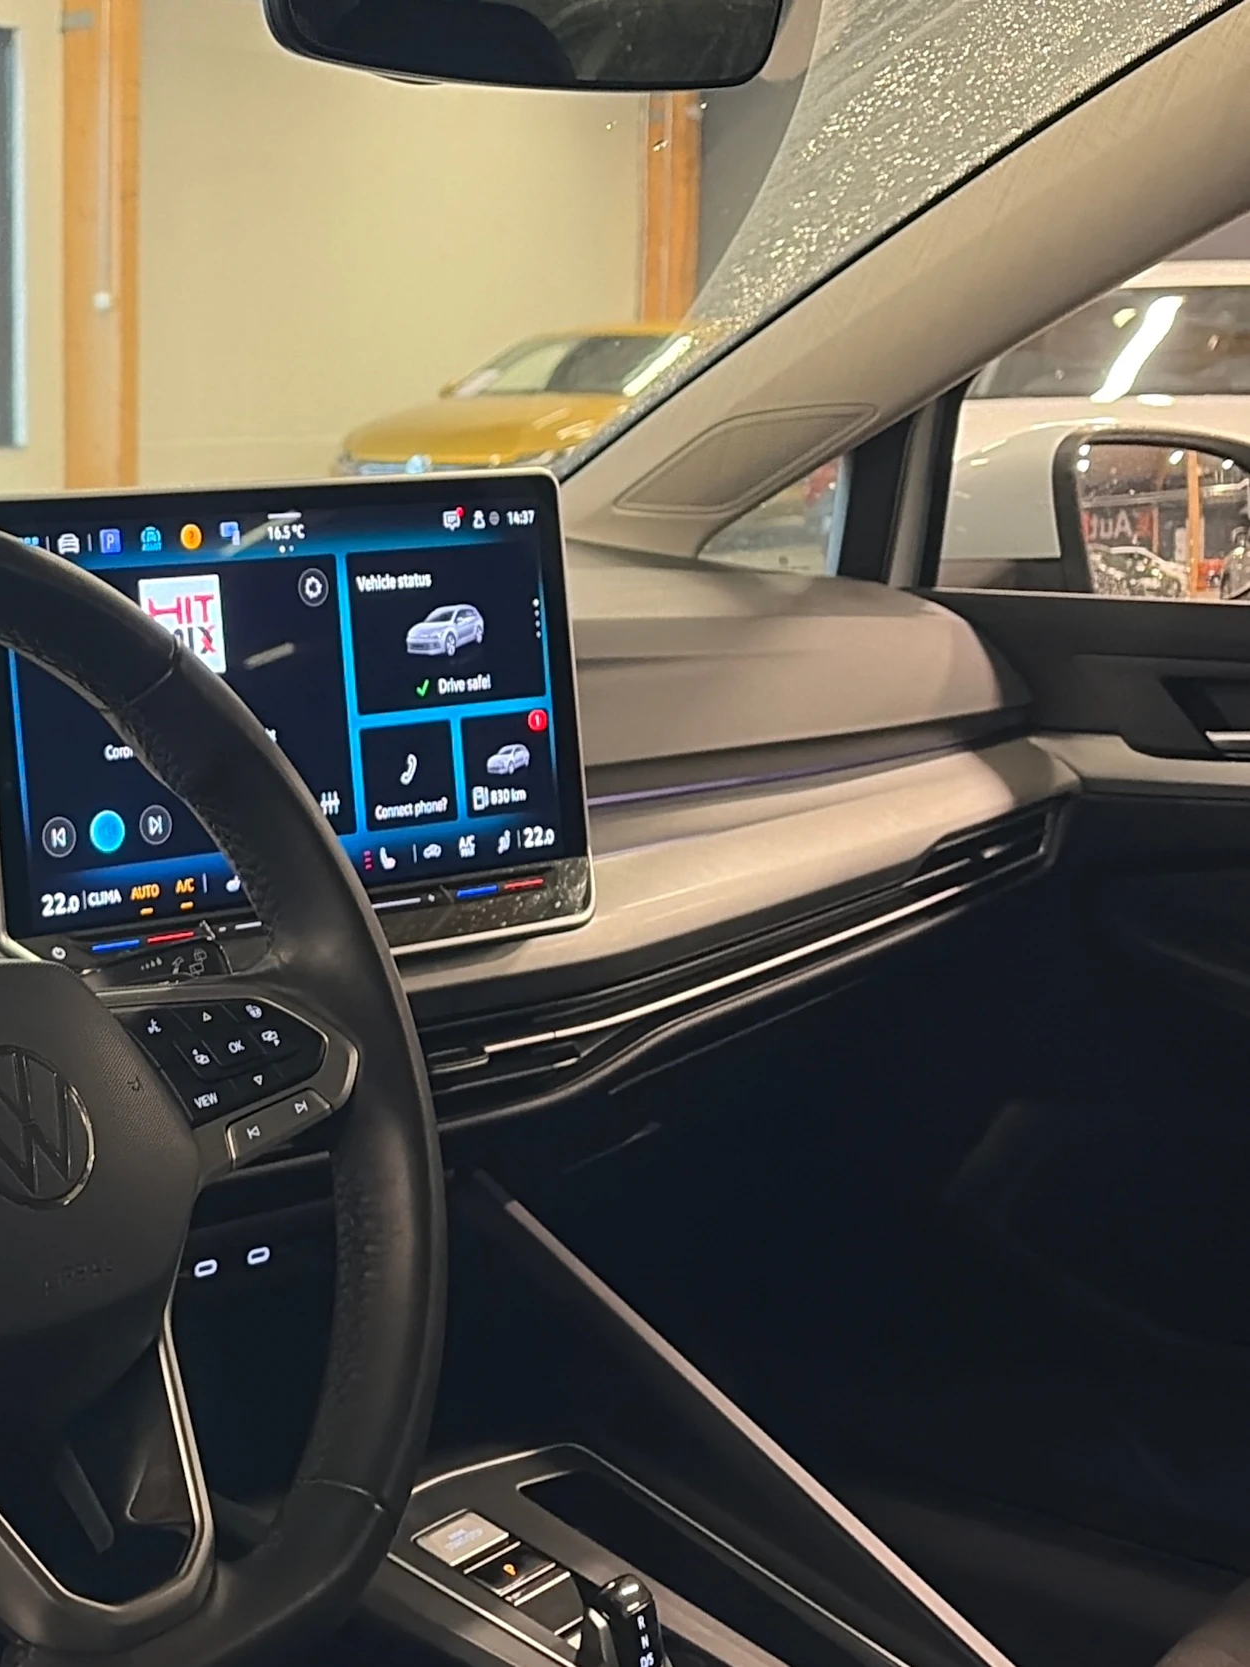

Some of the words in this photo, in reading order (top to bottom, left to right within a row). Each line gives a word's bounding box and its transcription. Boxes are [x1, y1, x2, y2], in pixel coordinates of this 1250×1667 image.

[506, 510, 535, 525] 14:37
[355, 573, 396, 592] Vehicle
[397, 573, 432, 589] status
[148, 594, 215, 625] HIT
[437, 677, 465, 695] Drive
[467, 674, 491, 692] safe!
[490, 789, 511, 805] 830
[512, 787, 527, 802] km
[375, 803, 413, 820] Connect
[414, 796, 448, 816] phone?
[523, 825, 555, 848] 22.0
[41, 892, 80, 917] 22.0
[87, 889, 122, 907] CLIMA
[131, 884, 160, 900] AUTO
[175, 877, 195, 893] A/C
[228, 1039, 245, 1054] OK
[194, 1092, 219, 1109] VIEW
[637, 1615, 646, 1630] R
[640, 1633, 650, 1650] N
